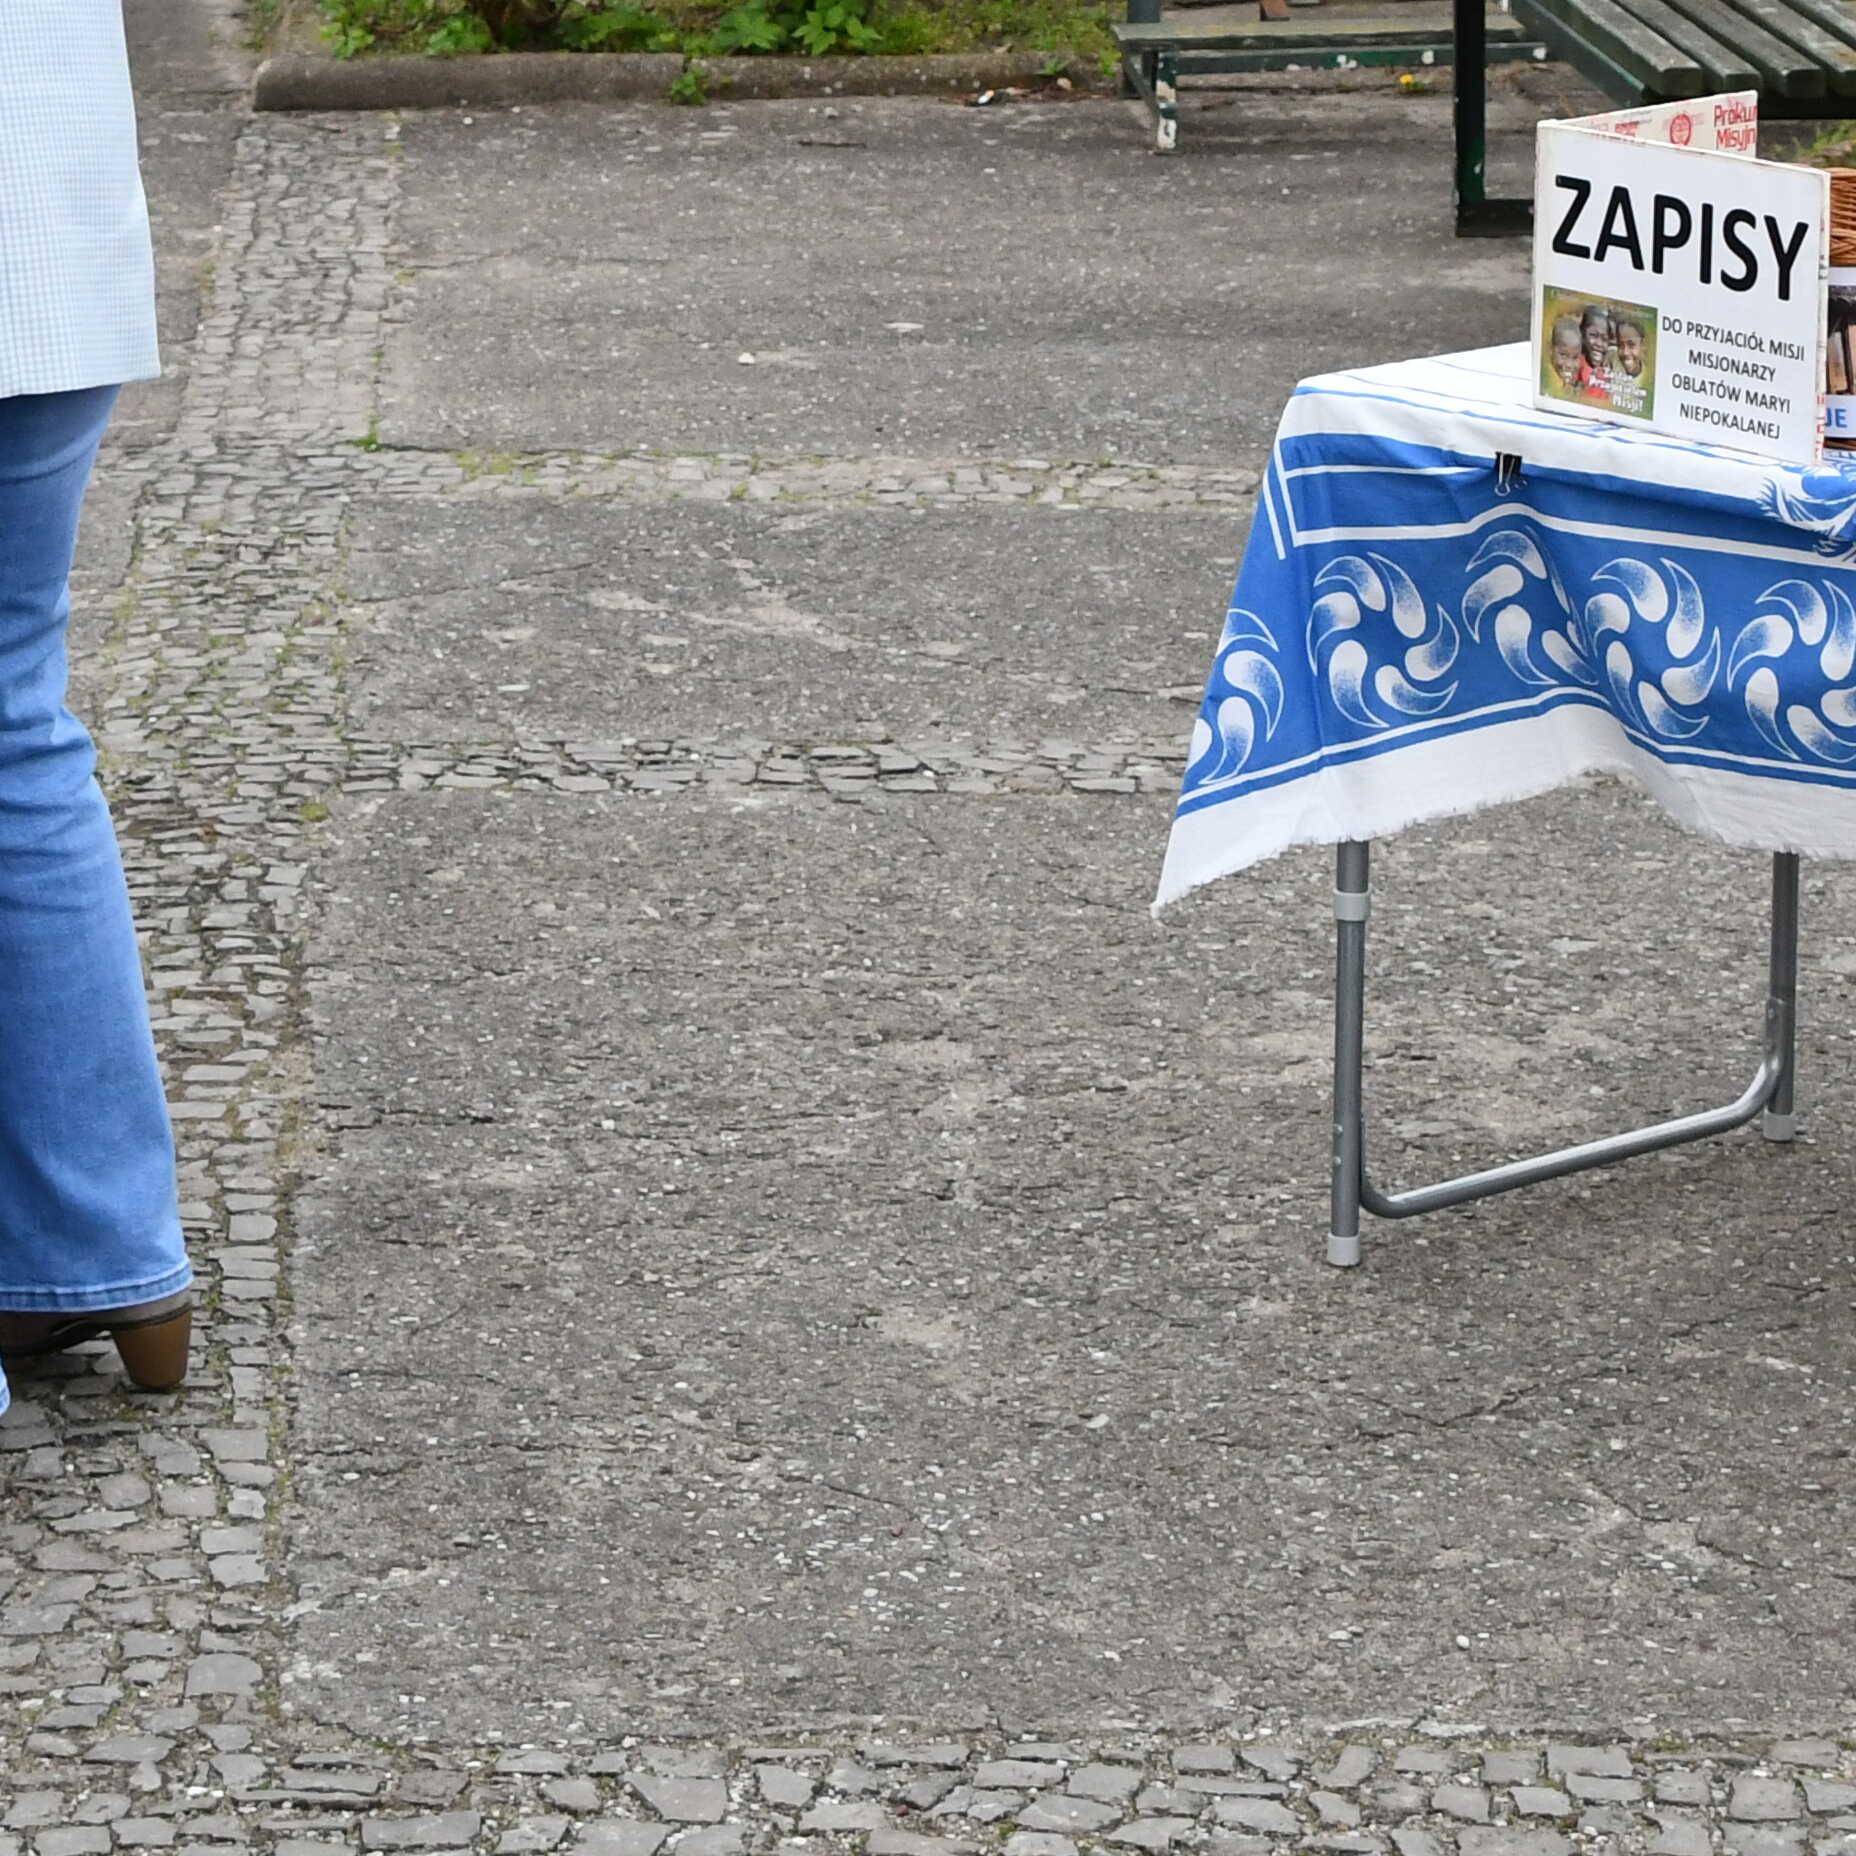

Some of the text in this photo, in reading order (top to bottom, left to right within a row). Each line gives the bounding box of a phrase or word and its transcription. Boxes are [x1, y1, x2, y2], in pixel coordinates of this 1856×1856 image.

[1552, 174, 1810, 302] ZAPISY
[1662, 315, 1805, 361] DO PRZYJACIÓŁ MISJI
[1688, 348, 1776, 382] MISJONARZY
[1672, 373, 1741, 403] OBLATÓW
[1745, 390, 1791, 414] MARYI
[1680, 402, 1781, 440] NIEPOKALANEJ
